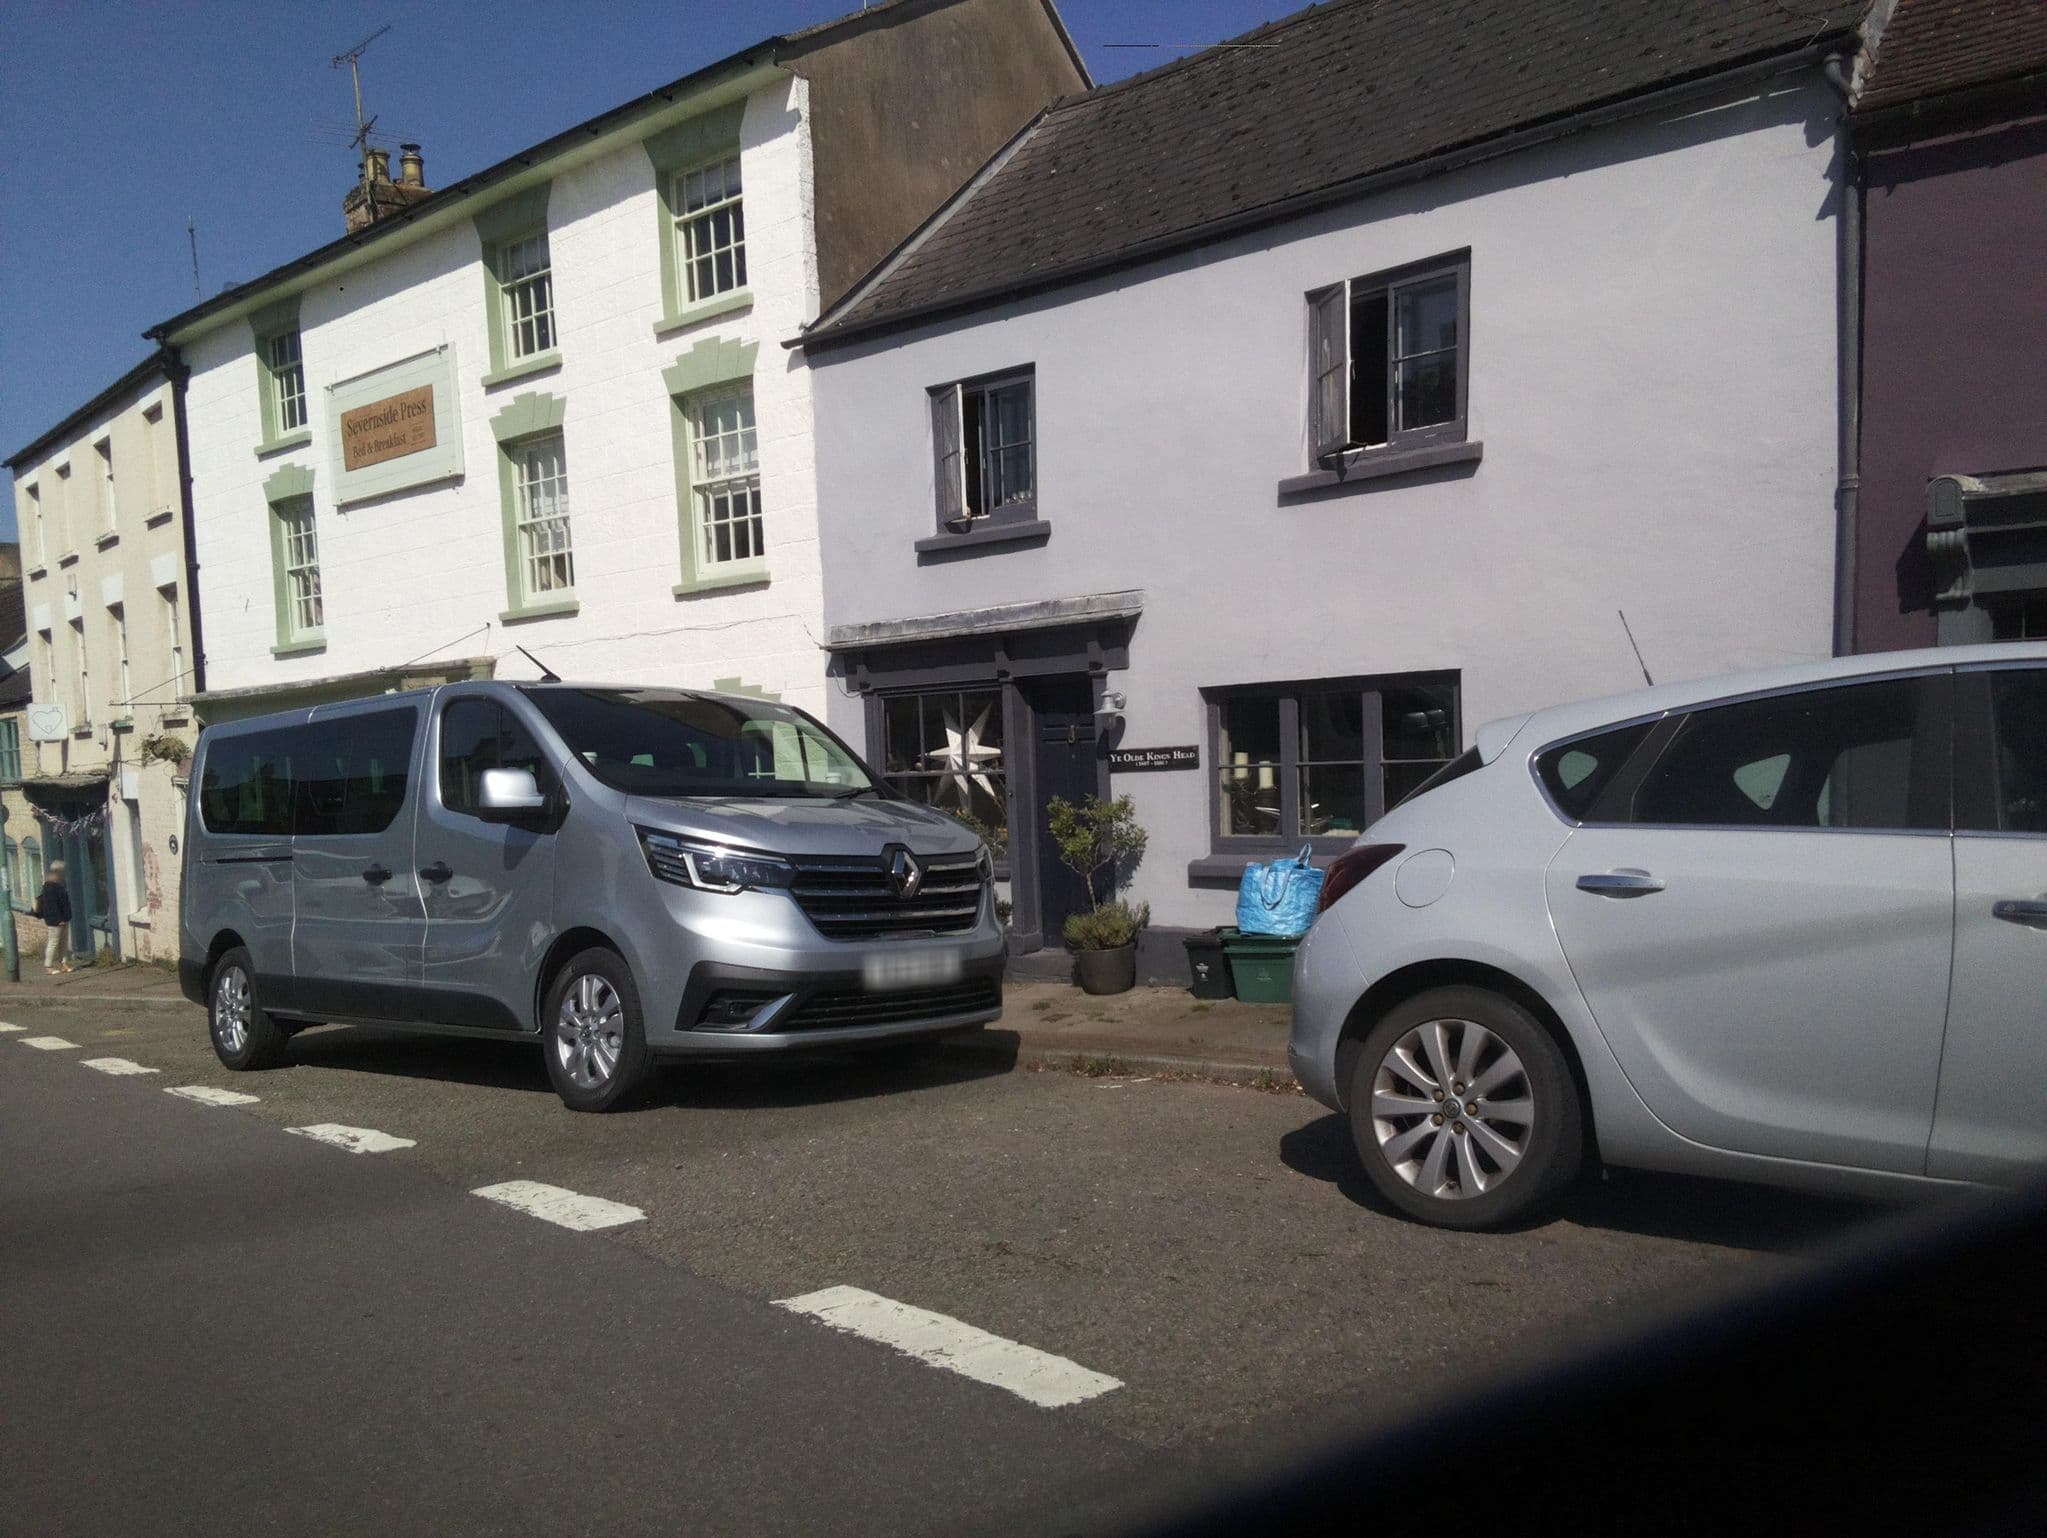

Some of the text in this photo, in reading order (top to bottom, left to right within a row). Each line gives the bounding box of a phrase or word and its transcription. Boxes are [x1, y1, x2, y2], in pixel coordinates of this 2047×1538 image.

[347, 405, 399, 437] Severnside
[401, 399, 427, 420] Press
[353, 443, 366, 458] Bed
[367, 442, 374, 454] &
[375, 433, 406, 453] Breakfast
